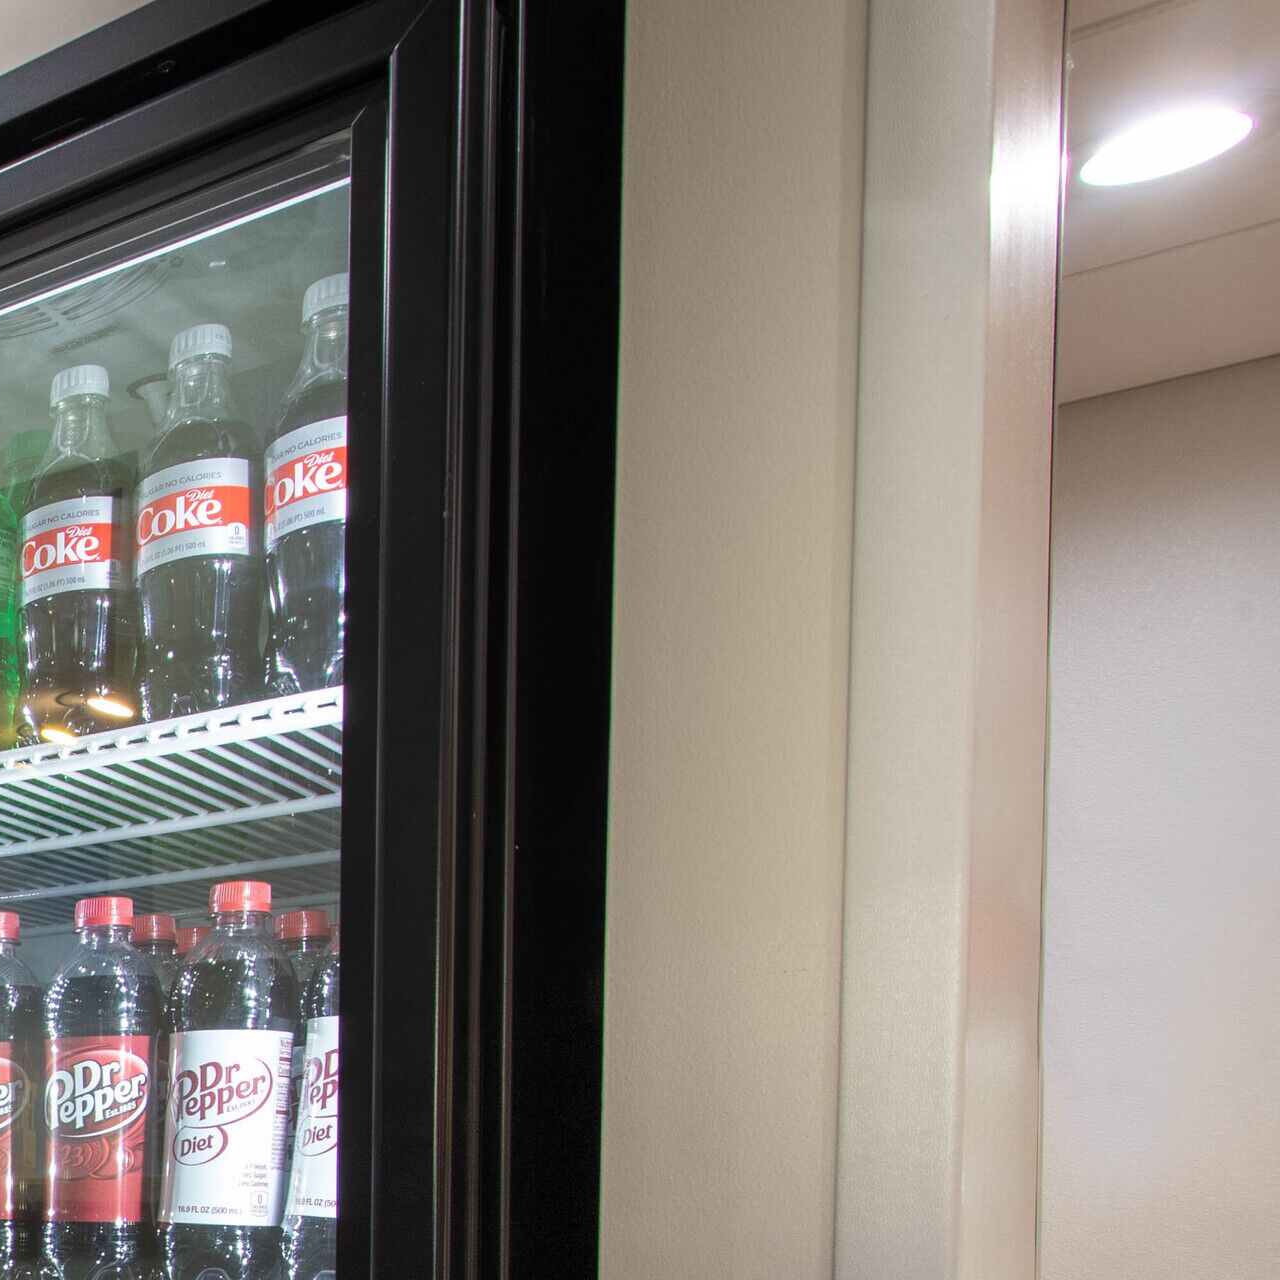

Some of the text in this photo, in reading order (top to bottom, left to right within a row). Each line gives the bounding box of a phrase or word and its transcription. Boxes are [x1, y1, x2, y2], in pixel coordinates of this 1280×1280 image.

[284, 432, 343, 456] NO CALORIES
[303, 450, 335, 468] Diet
[165, 470, 223, 491] NO CALORIES
[264, 457, 345, 516] Coke
[186, 488, 216, 501] Diet
[49, 508, 101, 525] NO CALORIES
[136, 494, 223, 546] Coke
[66, 525, 93, 538] Diet
[19, 529, 101, 577] Coke
[72, 1059, 121, 1097] Dr
[199, 1060, 241, 1093] Dr
[46, 1069, 146, 1131] Pepper
[175, 1069, 266, 1121] Pepper
[180, 1134, 214, 1158] Diet
[301, 1123, 333, 1149] Diet
[178, 1205, 190, 1213] 16.9
[200, 1205, 210, 1213] OZ
[314, 1199, 324, 1207] OZ
